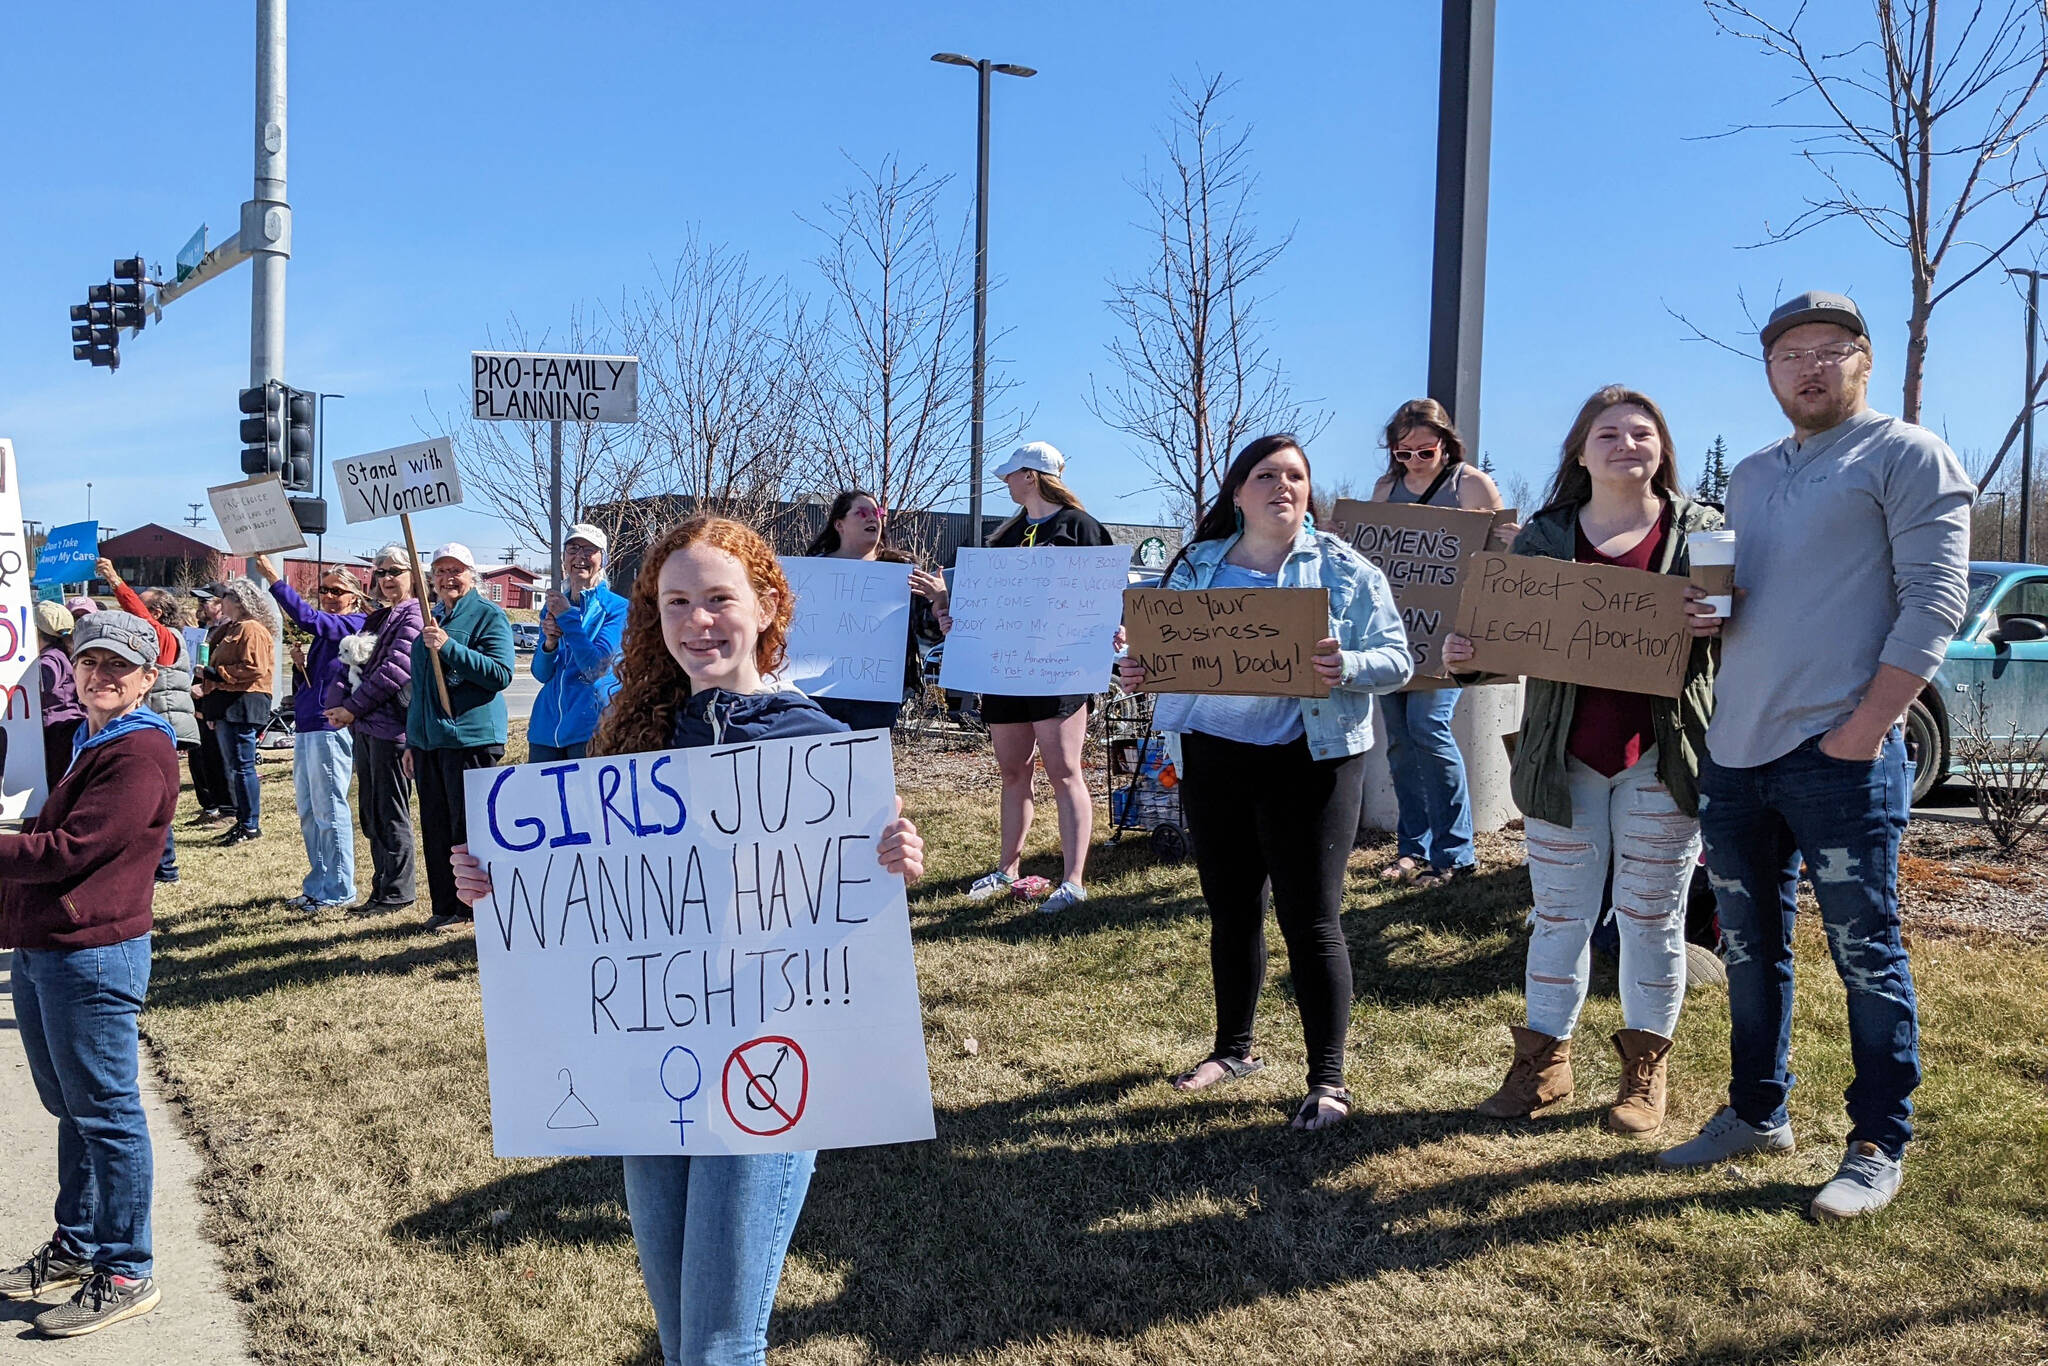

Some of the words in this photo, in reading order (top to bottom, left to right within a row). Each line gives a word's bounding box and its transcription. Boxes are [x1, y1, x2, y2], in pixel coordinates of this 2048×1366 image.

[475, 356, 626, 390] PRO-FAMILY
[475, 389, 600, 420] PLANNING
[347, 455, 397, 485] Stand
[408, 448, 442, 474] with
[359, 481, 451, 516] Women
[44, 541, 62, 551] Don't
[62, 538, 79, 548] Take
[58, 552, 70, 564] My
[986, 552, 1007, 569] YOU
[1016, 553, 1055, 571] SAID
[1096, 556, 1124, 569] BODY
[828, 572, 886, 602] THE
[1031, 577, 1050, 588] TO
[1056, 577, 1078, 588] THE
[1482, 558, 1574, 600] Protect
[1582, 577, 1657, 618] SAFE,
[997, 595, 1033, 608] COME
[1047, 597, 1069, 609] FOR
[1132, 594, 1183, 624] Mind
[1197, 593, 1256, 622] Your
[836, 611, 882, 635] AND
[954, 618, 986, 632] BODY
[995, 618, 1025, 631] AND
[1031, 619, 1048, 632] MY
[1160, 624, 1280, 643] Business
[1468, 607, 1558, 651] LEGAL
[1139, 653, 1183, 677] NOT
[1192, 658, 1223, 687] my
[1233, 643, 1302, 684] body!
[1956, 683, 1970, 692] GT
[487, 756, 687, 852] GIRLS
[710, 735, 879, 835] JUST
[488, 846, 711, 951] WANNA
[733, 835, 871, 935] HAVE
[591, 946, 851, 1034] RIGHTS!!!
